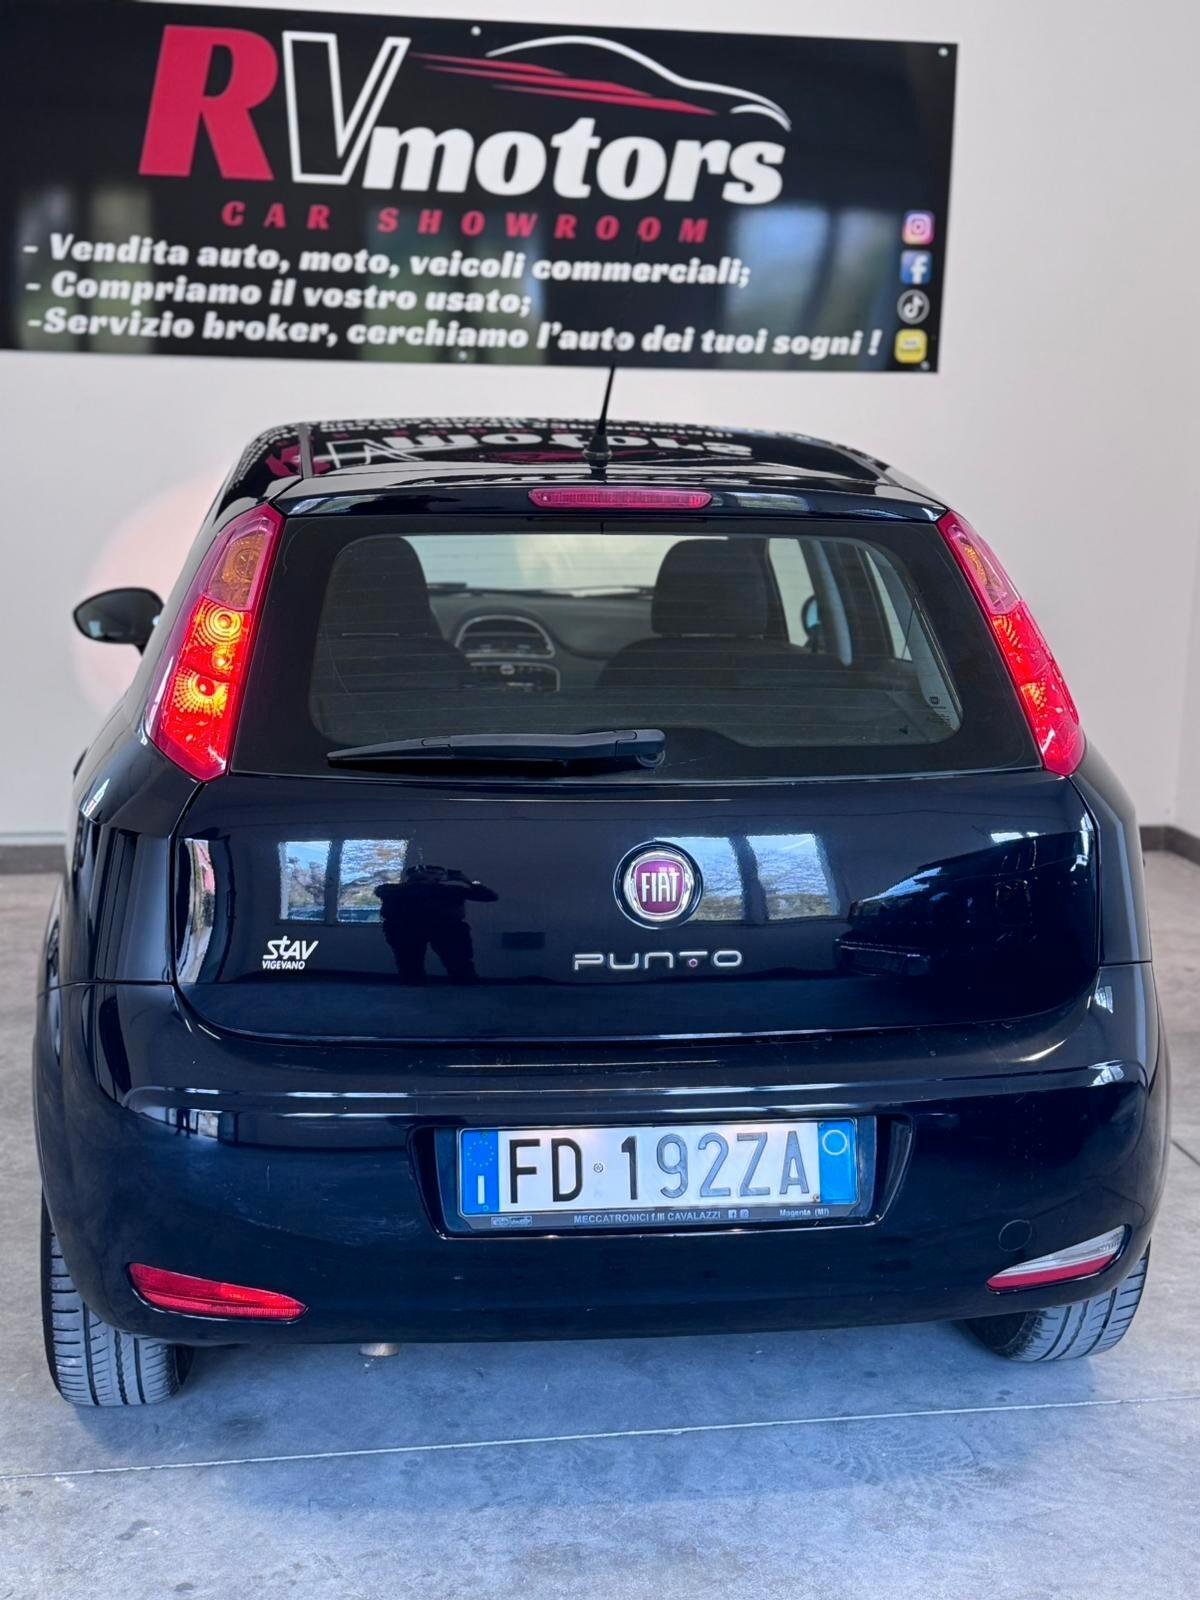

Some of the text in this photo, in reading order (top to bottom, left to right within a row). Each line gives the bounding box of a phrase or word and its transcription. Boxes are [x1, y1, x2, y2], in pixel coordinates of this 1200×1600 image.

[221, 201, 708, 243] CAR SHOWROOM
[50, 232, 189, 266] Vendita
[197, 244, 290, 274] auto,
[299, 249, 400, 278] moto,
[410, 250, 526, 279] veicoli
[532, 256, 751, 288] commerciali;
[51, 270, 262, 306] Compriamo
[269, 278, 296, 306] il
[303, 285, 417, 310] vostro
[425, 289, 532, 317] usato;
[202, 311, 338, 347] broker,
[346, 318, 529, 348] cerchiamo
[641, 324, 695, 353] dei
[701, 328, 768, 354] tuoi
[772, 329, 863, 360] sogni
[641, 870, 680, 902] FIAT
[262, 960, 305, 970] VIGEVANO
[574, 950, 742, 970] PUNTO
[574, 1213, 649, 1225] MECCATRONICI
[667, 1211, 721, 1222] CAVALAZZI
[779, 1208, 811, 1219] Magenta
